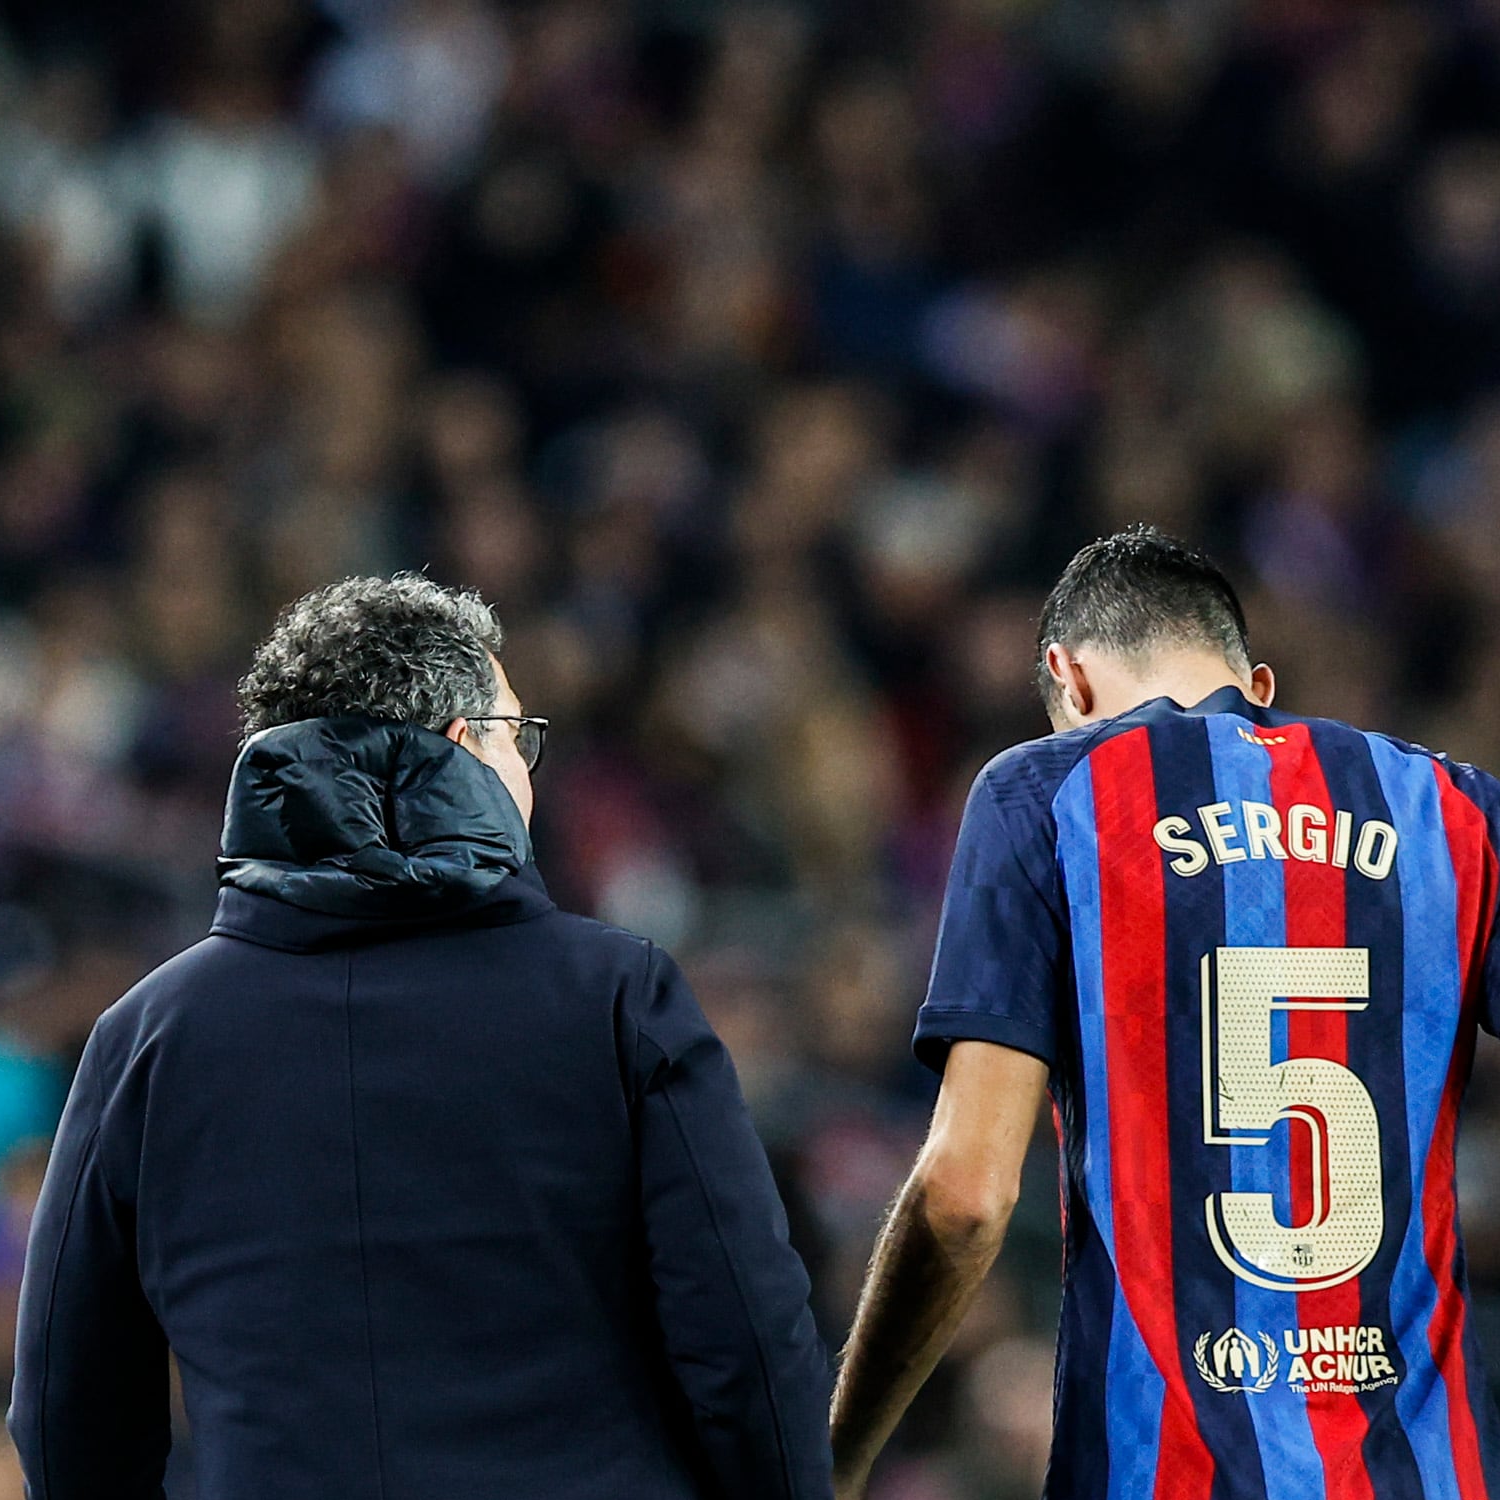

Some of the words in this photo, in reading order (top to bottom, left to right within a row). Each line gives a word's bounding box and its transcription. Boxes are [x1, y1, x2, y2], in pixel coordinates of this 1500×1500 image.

[1152, 799, 1398, 881] SERGIO
[1200, 946, 1384, 1292] 5
[1283, 1325, 1386, 1355] UNHCR
[1286, 1354, 1396, 1383] ACNUR
[1288, 1383, 1310, 1394] The
[1310, 1381, 1329, 1393] UN
[1360, 1375, 1399, 1393] Agency
